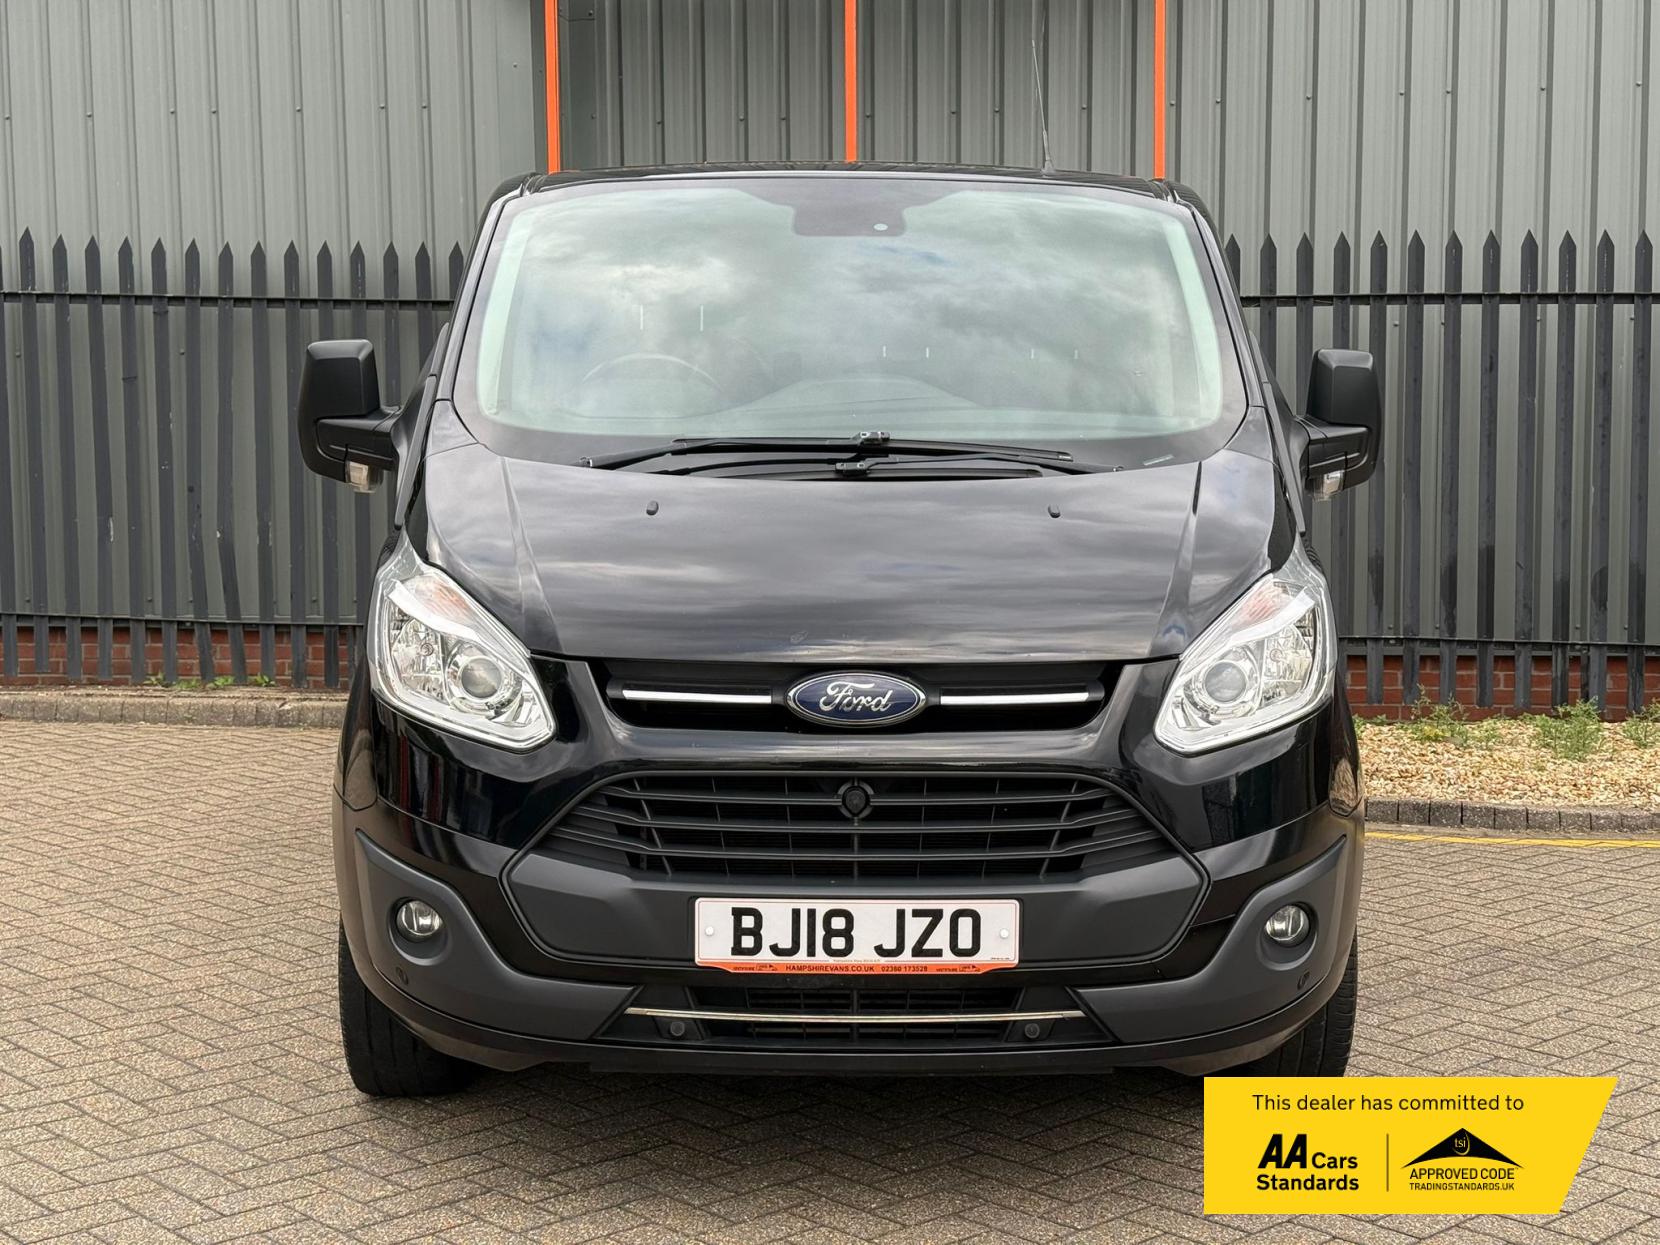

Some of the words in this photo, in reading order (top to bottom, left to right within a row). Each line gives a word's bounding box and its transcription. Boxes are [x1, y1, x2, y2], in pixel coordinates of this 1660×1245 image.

[819, 681, 893, 712] Ford
[731, 907, 854, 958] BJ18
[873, 908, 982, 958] JZO
